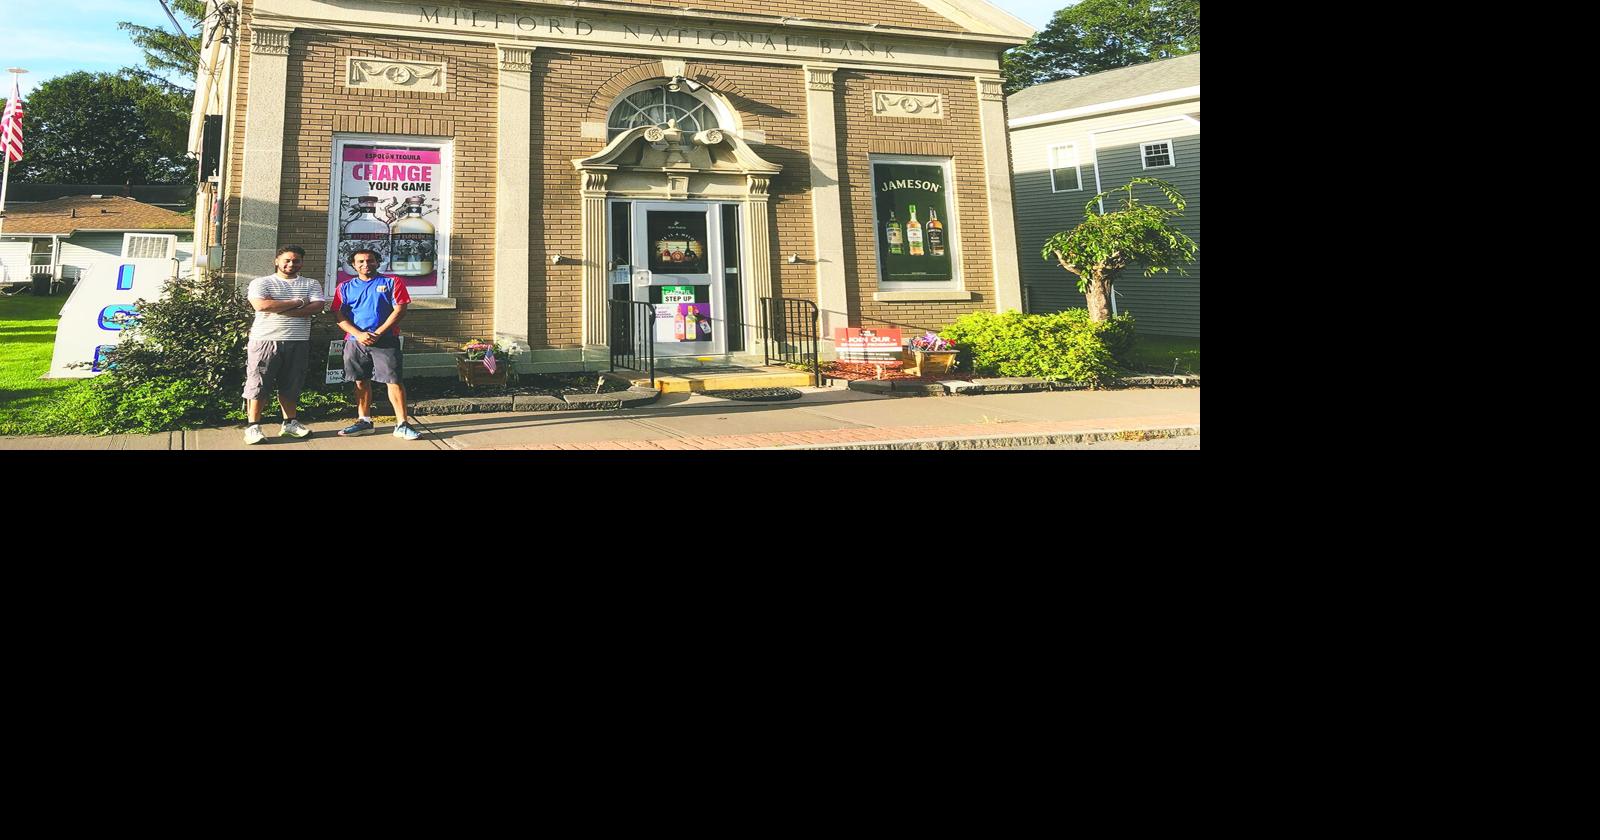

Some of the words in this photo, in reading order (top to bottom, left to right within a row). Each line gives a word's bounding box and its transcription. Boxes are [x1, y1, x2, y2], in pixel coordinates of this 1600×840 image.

[418, 7, 594, 36] MILFORD
[623, 24, 797, 53] NATIONAL
[820, 38, 896, 59] BANK
[352, 163, 432, 182] CHANGE
[368, 182, 399, 191] YOUR
[401, 183, 431, 192] GAME
[881, 179, 940, 193] JAMESON
